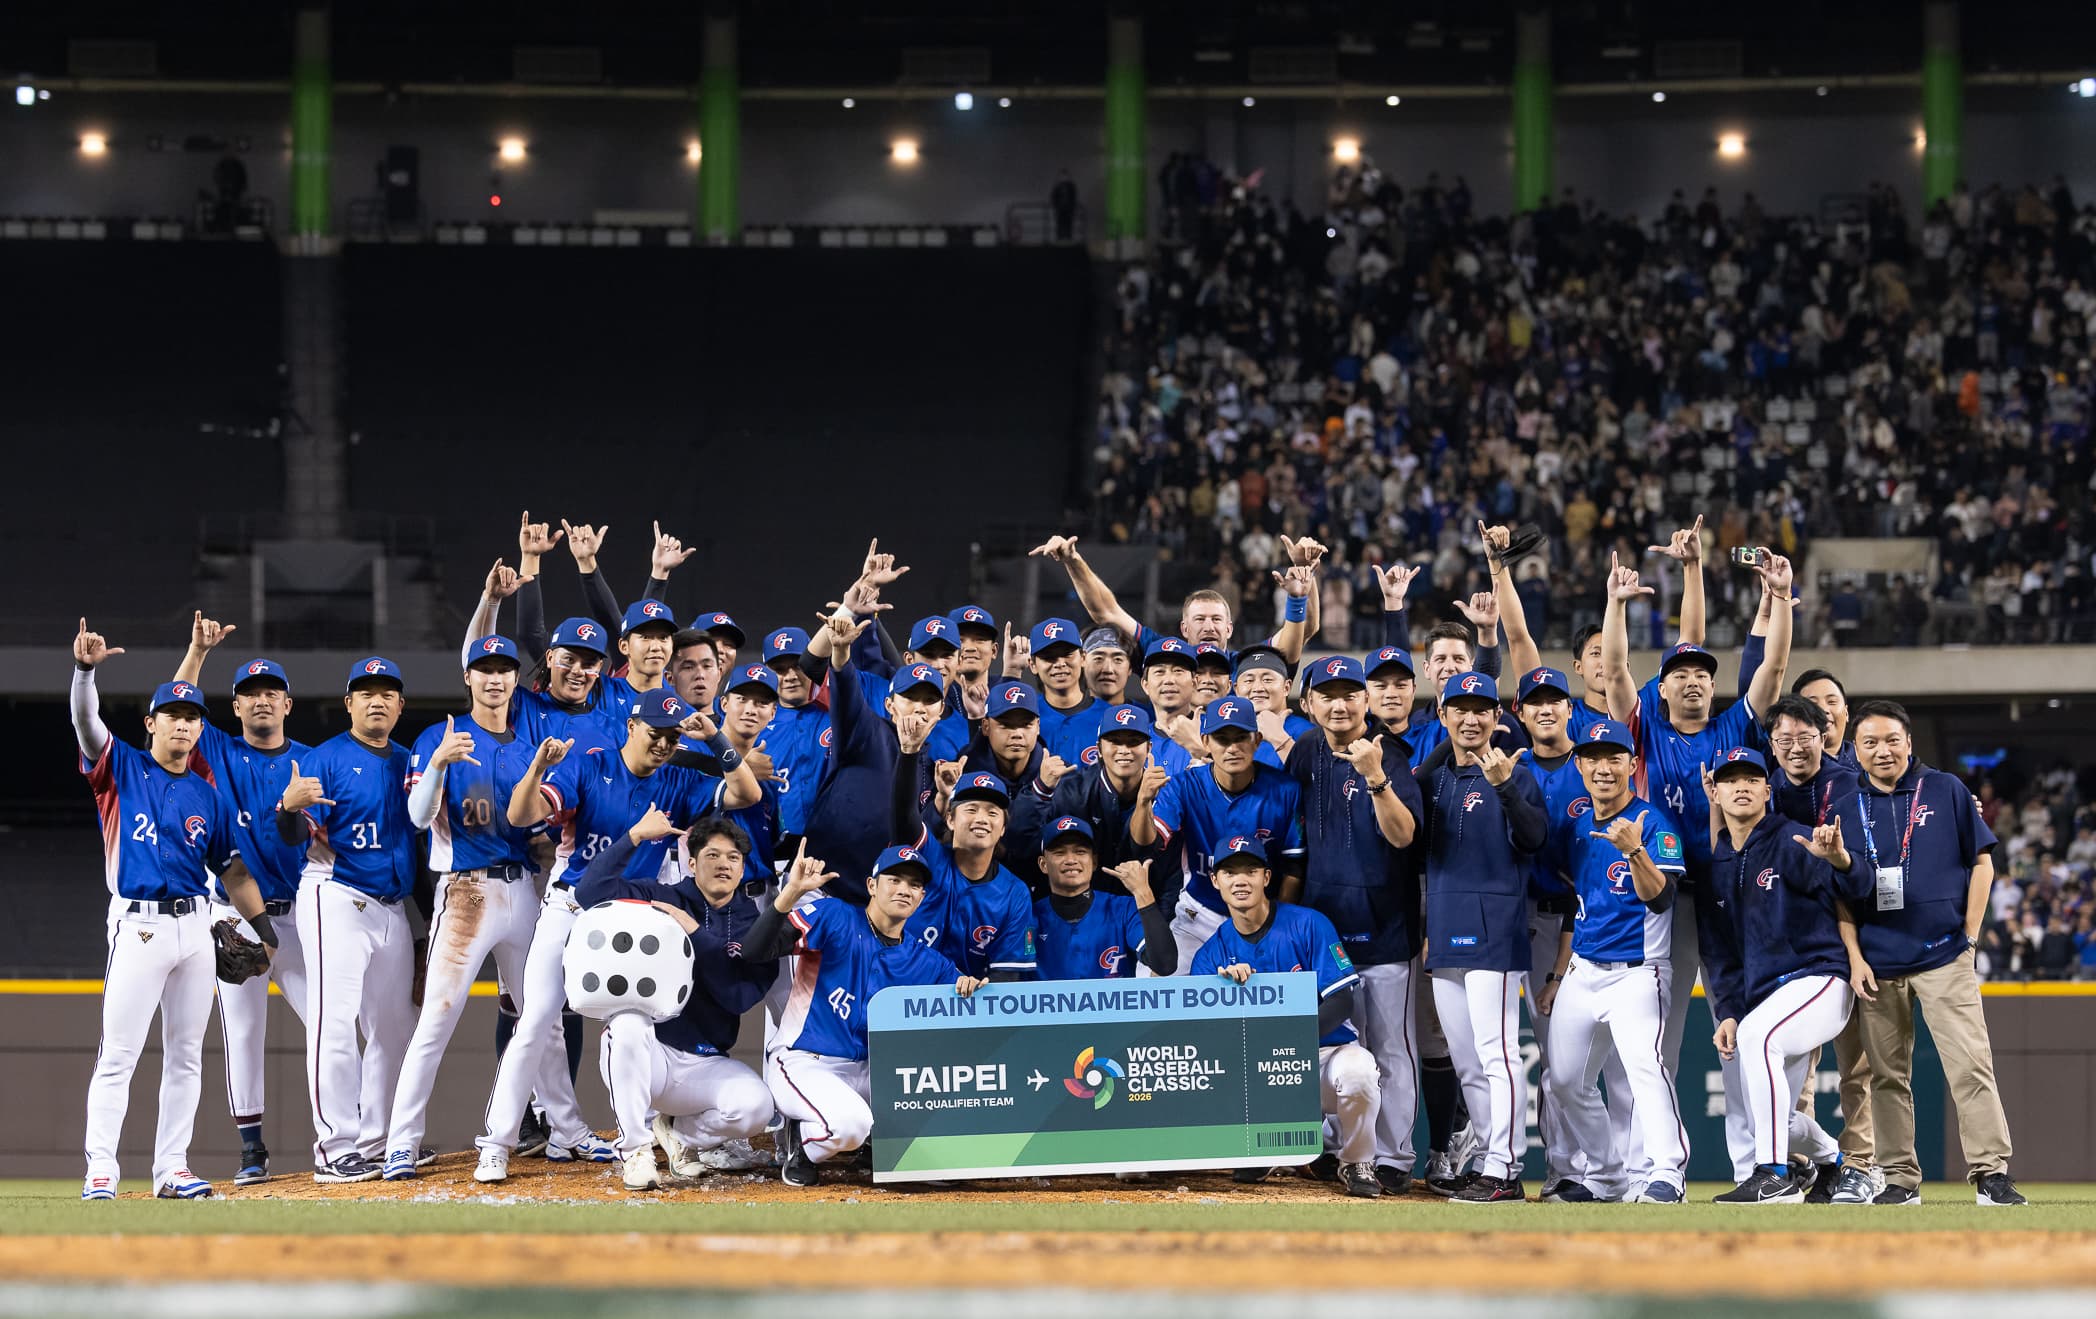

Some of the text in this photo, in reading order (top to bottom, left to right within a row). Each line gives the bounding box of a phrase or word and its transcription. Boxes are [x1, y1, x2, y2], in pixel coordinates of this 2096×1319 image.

[462, 798, 490, 825] 20
[133, 813, 157, 845] 24
[352, 823, 381, 849] 31
[829, 987, 855, 1020] 45
[904, 985, 1284, 1018] MAIN TOURNAMENT BOUND!
[1127, 1045, 1198, 1061] WORLD
[1272, 1047, 1296, 1056] DATE
[1128, 1059, 1226, 1077] BASEBALL
[1257, 1059, 1312, 1073] MARCH
[895, 1063, 1007, 1094] TAIPEI
[1267, 1073, 1303, 1086] 2026
[894, 1097, 1014, 1111] POOL QUALIFIER TEAM
[1128, 1092, 1152, 1102] 2026
